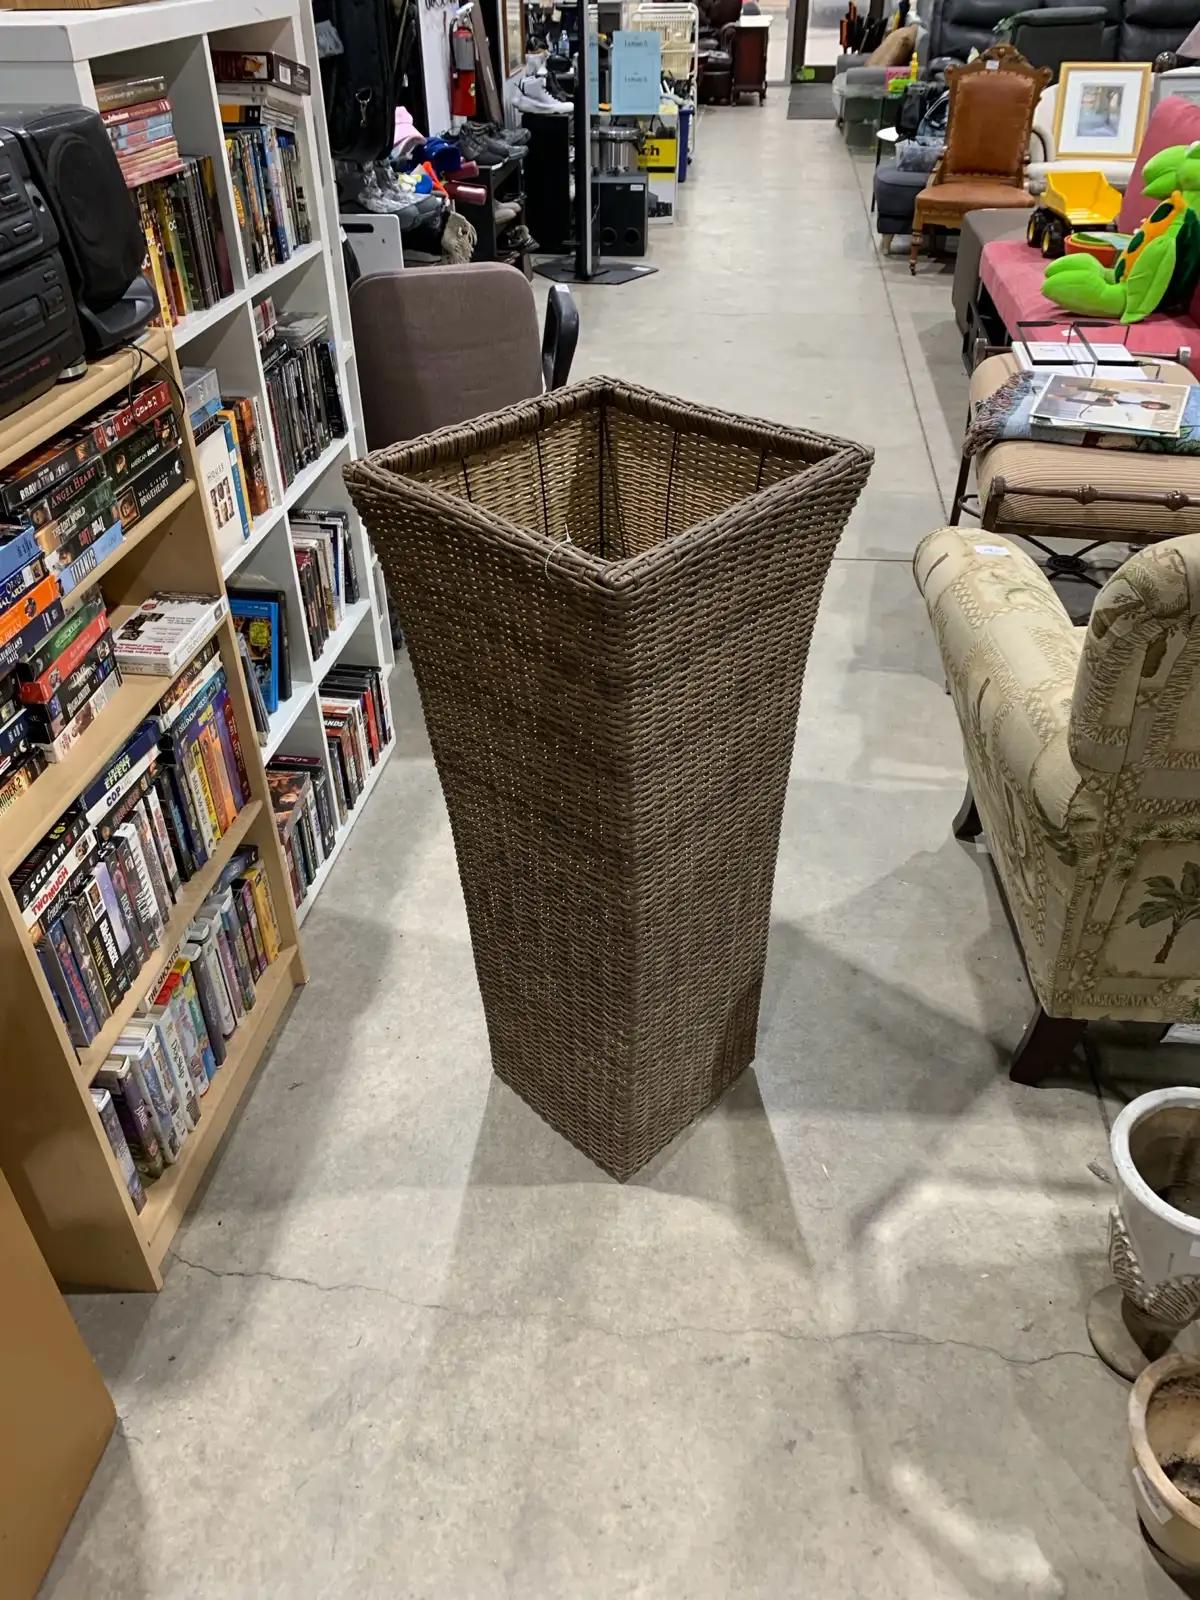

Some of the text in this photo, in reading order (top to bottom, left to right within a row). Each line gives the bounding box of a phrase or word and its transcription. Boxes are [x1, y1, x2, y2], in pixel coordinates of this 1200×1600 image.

[51, 486, 74, 509] ANGEL
[73, 467, 96, 487] HEART
[140, 476, 169, 507] BRAVEHEART
[70, 506, 86, 524] WORLD
[70, 546, 97, 584] TITANIC
[104, 760, 131, 789] EFFECT
[106, 787, 121, 807] COP
[30, 843, 66, 892] SCREAM
[136, 894, 150, 923] PALMS
[157, 944, 181, 989] SHOOTIST
